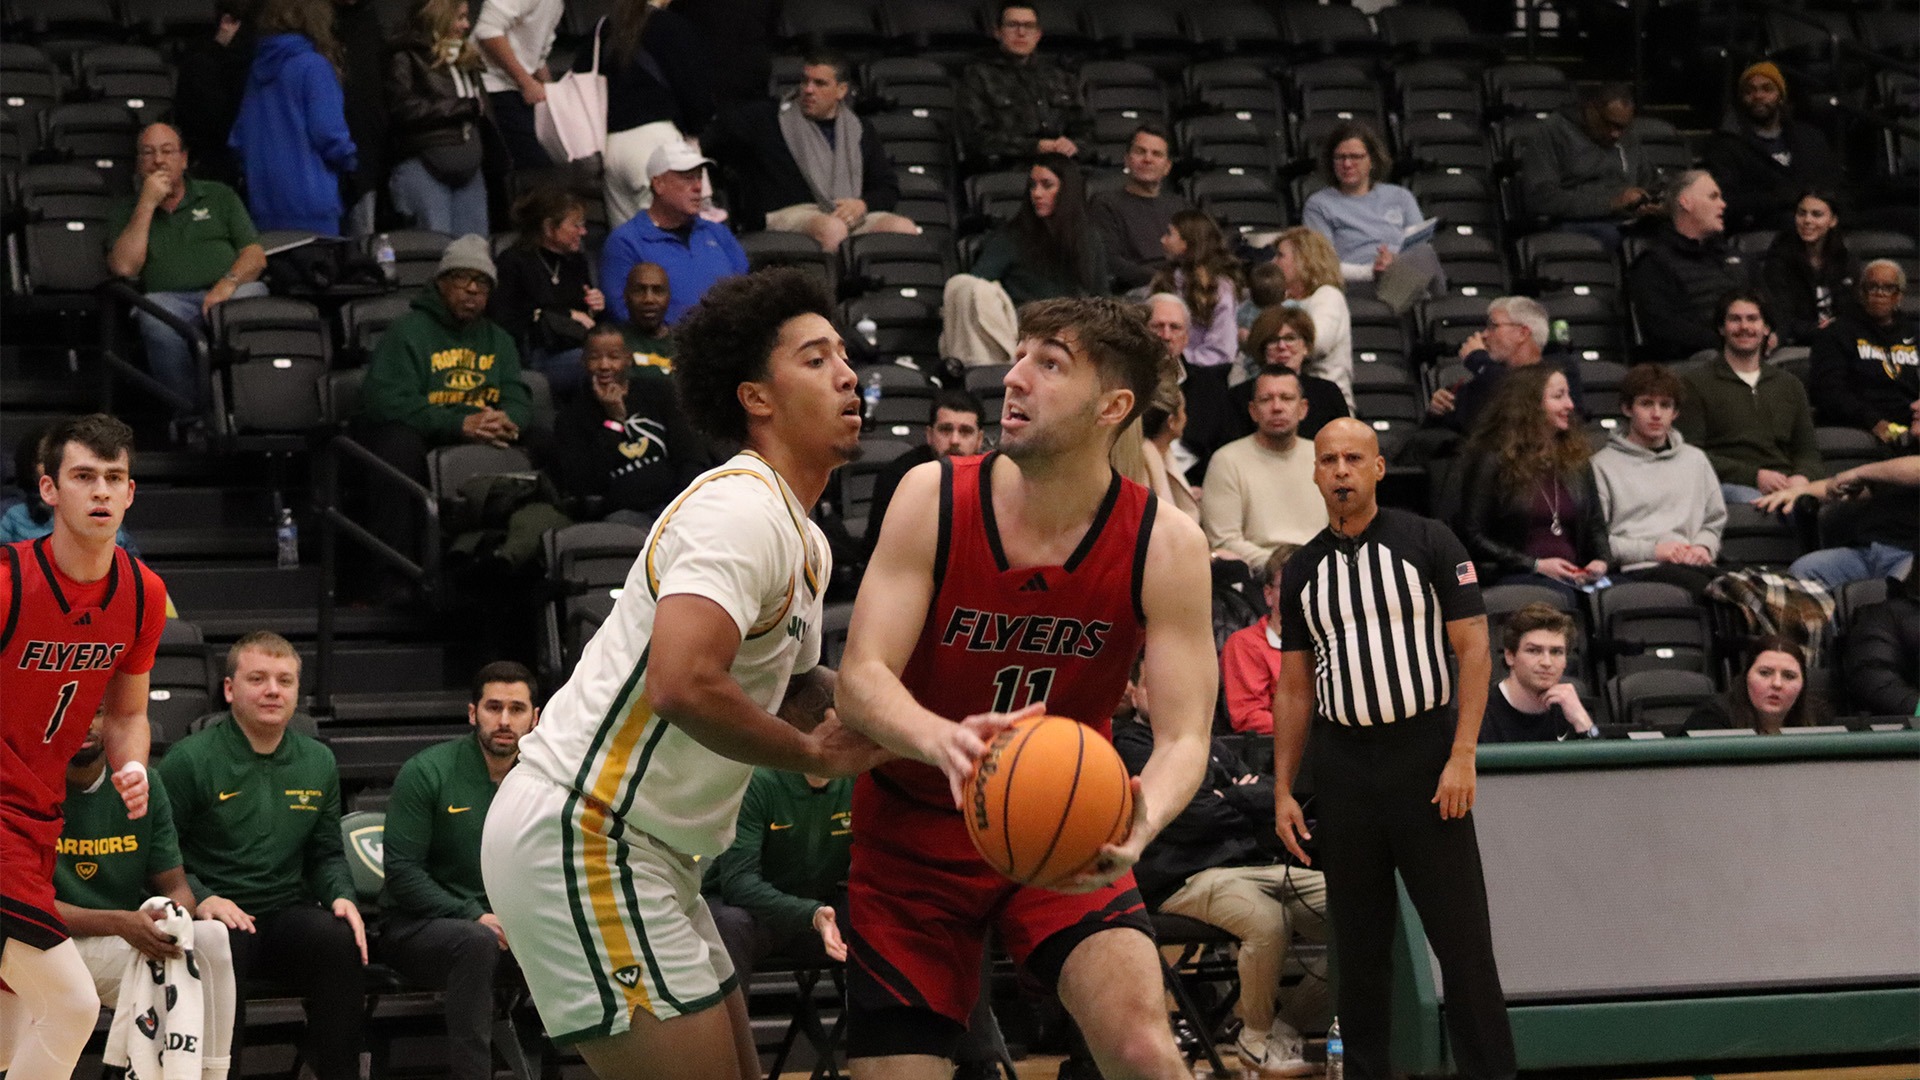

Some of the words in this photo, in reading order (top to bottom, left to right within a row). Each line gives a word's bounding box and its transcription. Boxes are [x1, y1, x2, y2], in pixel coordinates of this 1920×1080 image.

[478, 354, 495, 371] OF
[1857, 344, 1919, 366] WARIORS
[941, 605, 1114, 658] FLYERS
[17, 639, 125, 672] FLYERS
[991, 664, 1057, 714] 11
[42, 680, 79, 743] 1
[55, 834, 139, 856] ARRIORS
